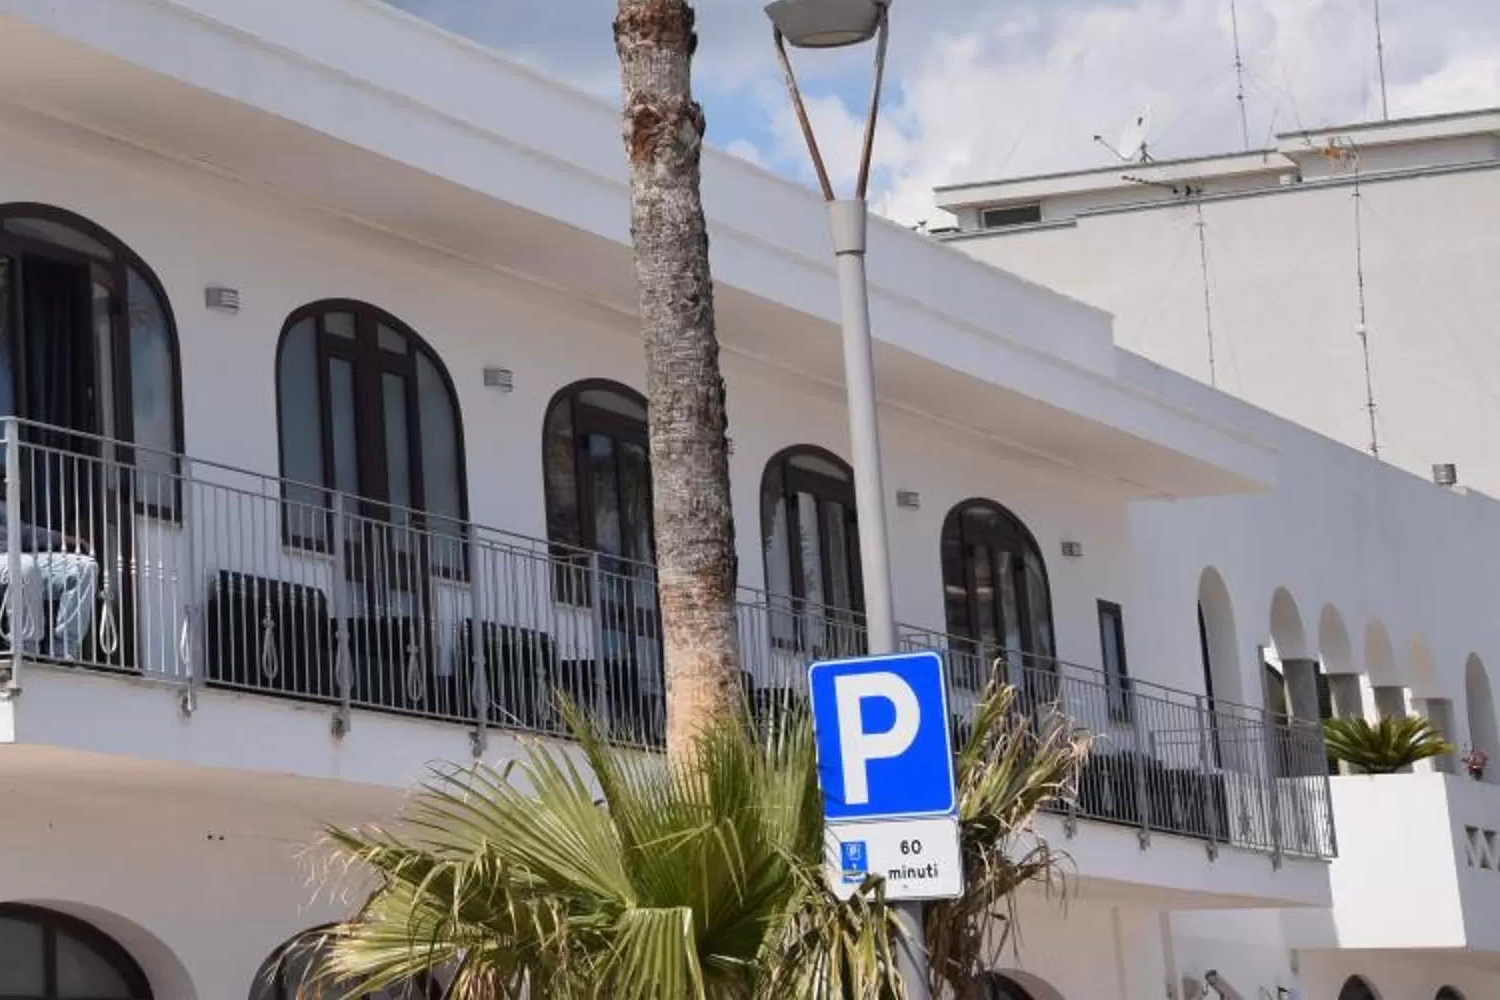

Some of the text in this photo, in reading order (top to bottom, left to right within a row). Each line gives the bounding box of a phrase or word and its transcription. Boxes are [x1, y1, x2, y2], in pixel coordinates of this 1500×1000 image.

[834, 671, 921, 805] P
[899, 839, 922, 856] 60
[888, 862, 939, 880] minuti
